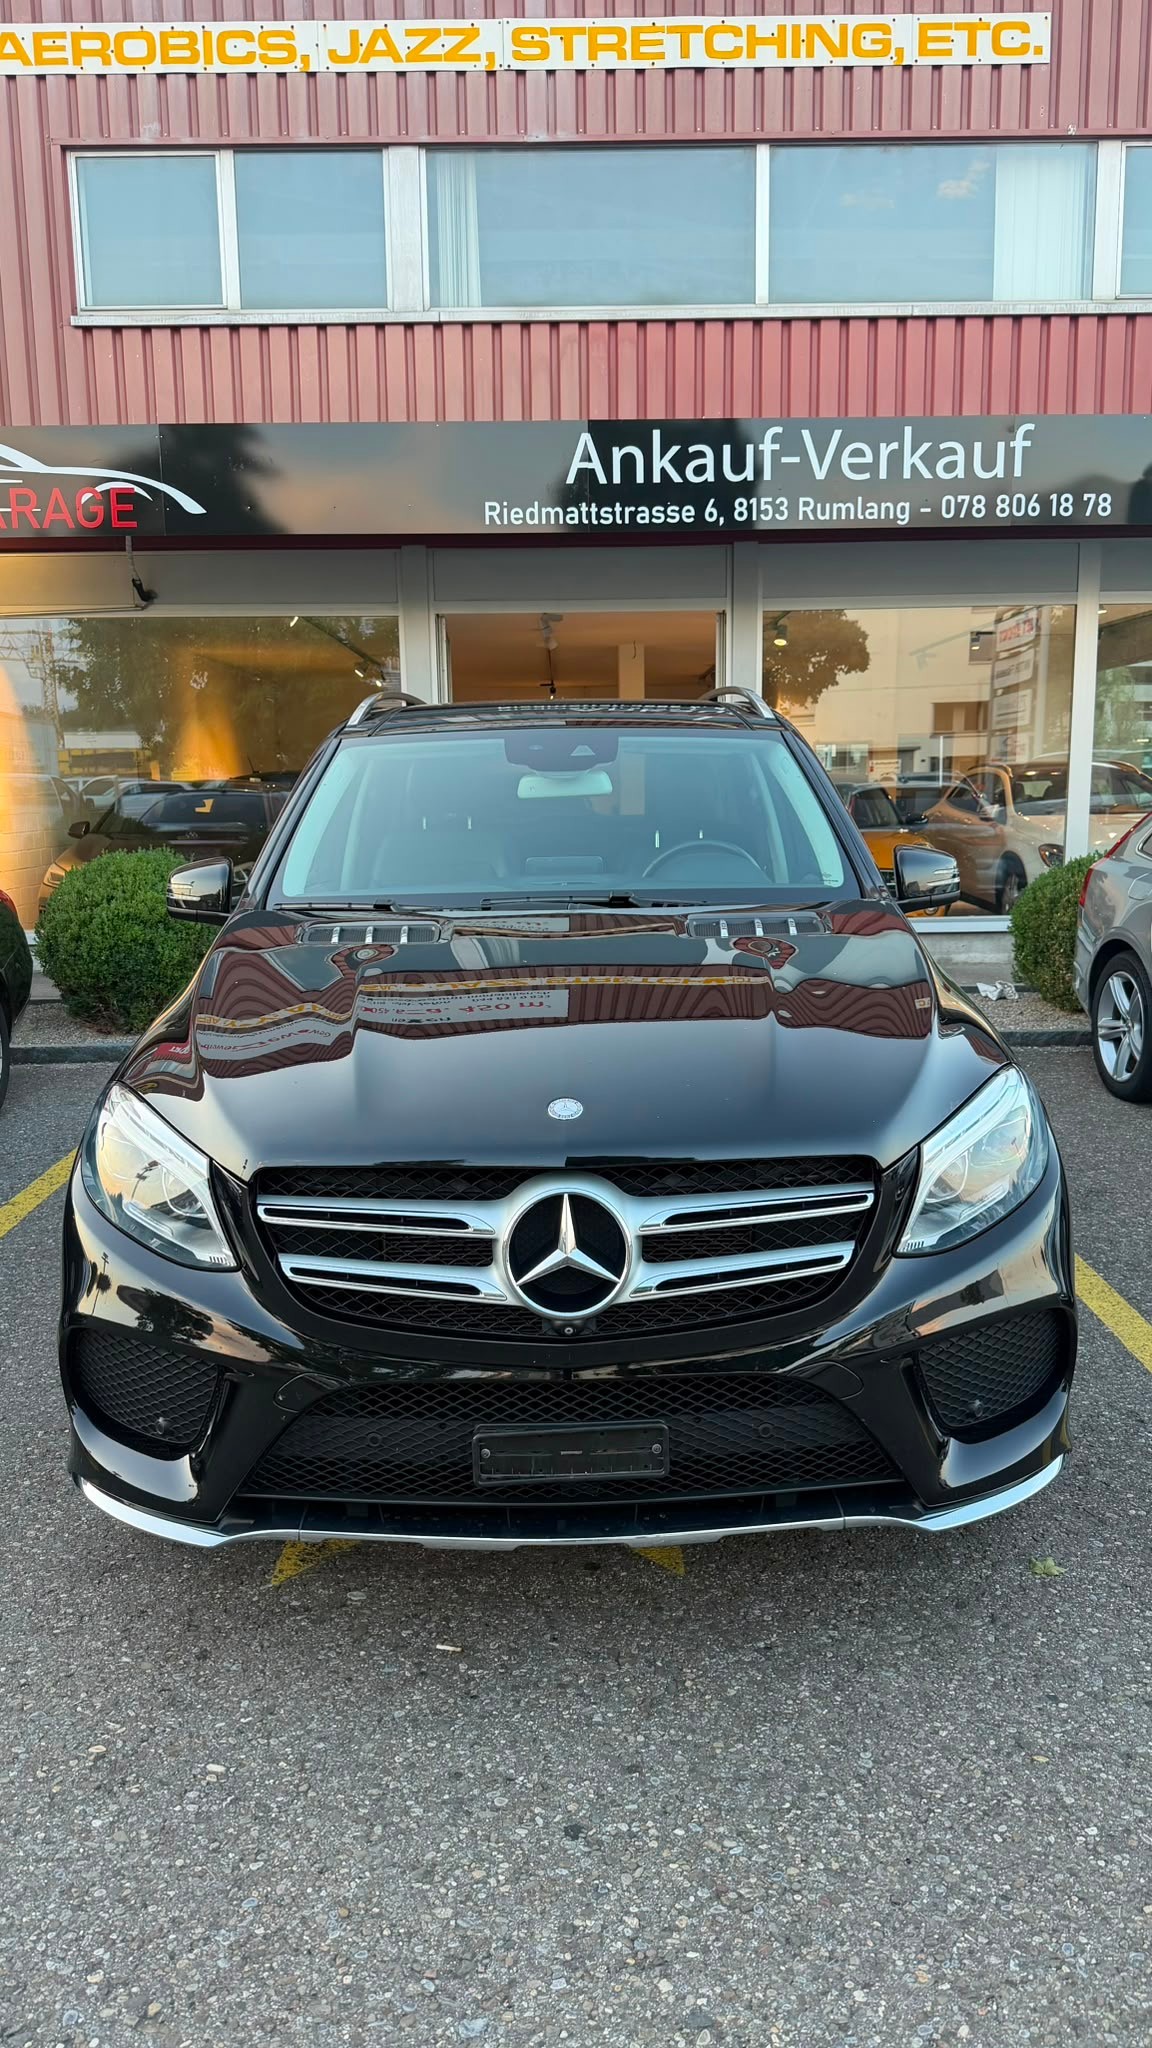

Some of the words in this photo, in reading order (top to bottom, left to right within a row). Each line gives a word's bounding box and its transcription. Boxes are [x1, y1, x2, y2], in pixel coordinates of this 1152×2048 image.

[0, 29, 311, 73] AEROBICS,
[327, 26, 497, 72] JAZZ,
[511, 22, 906, 68] STRETCHING,
[917, 20, 1044, 59] ETC.
[565, 424, 1036, 485] Ankauf-Verkauf
[0, 487, 138, 529] RAGE
[484, 500, 695, 526] Riedmattstrasse
[704, 498, 724, 526] 6,
[733, 496, 789, 522] 8153
[798, 495, 911, 526] Rumlang
[941, 494, 986, 519] 078
[995, 493, 1041, 518] 806
[1049, 493, 1074, 517] 18
[1083, 492, 1112, 517] 78
